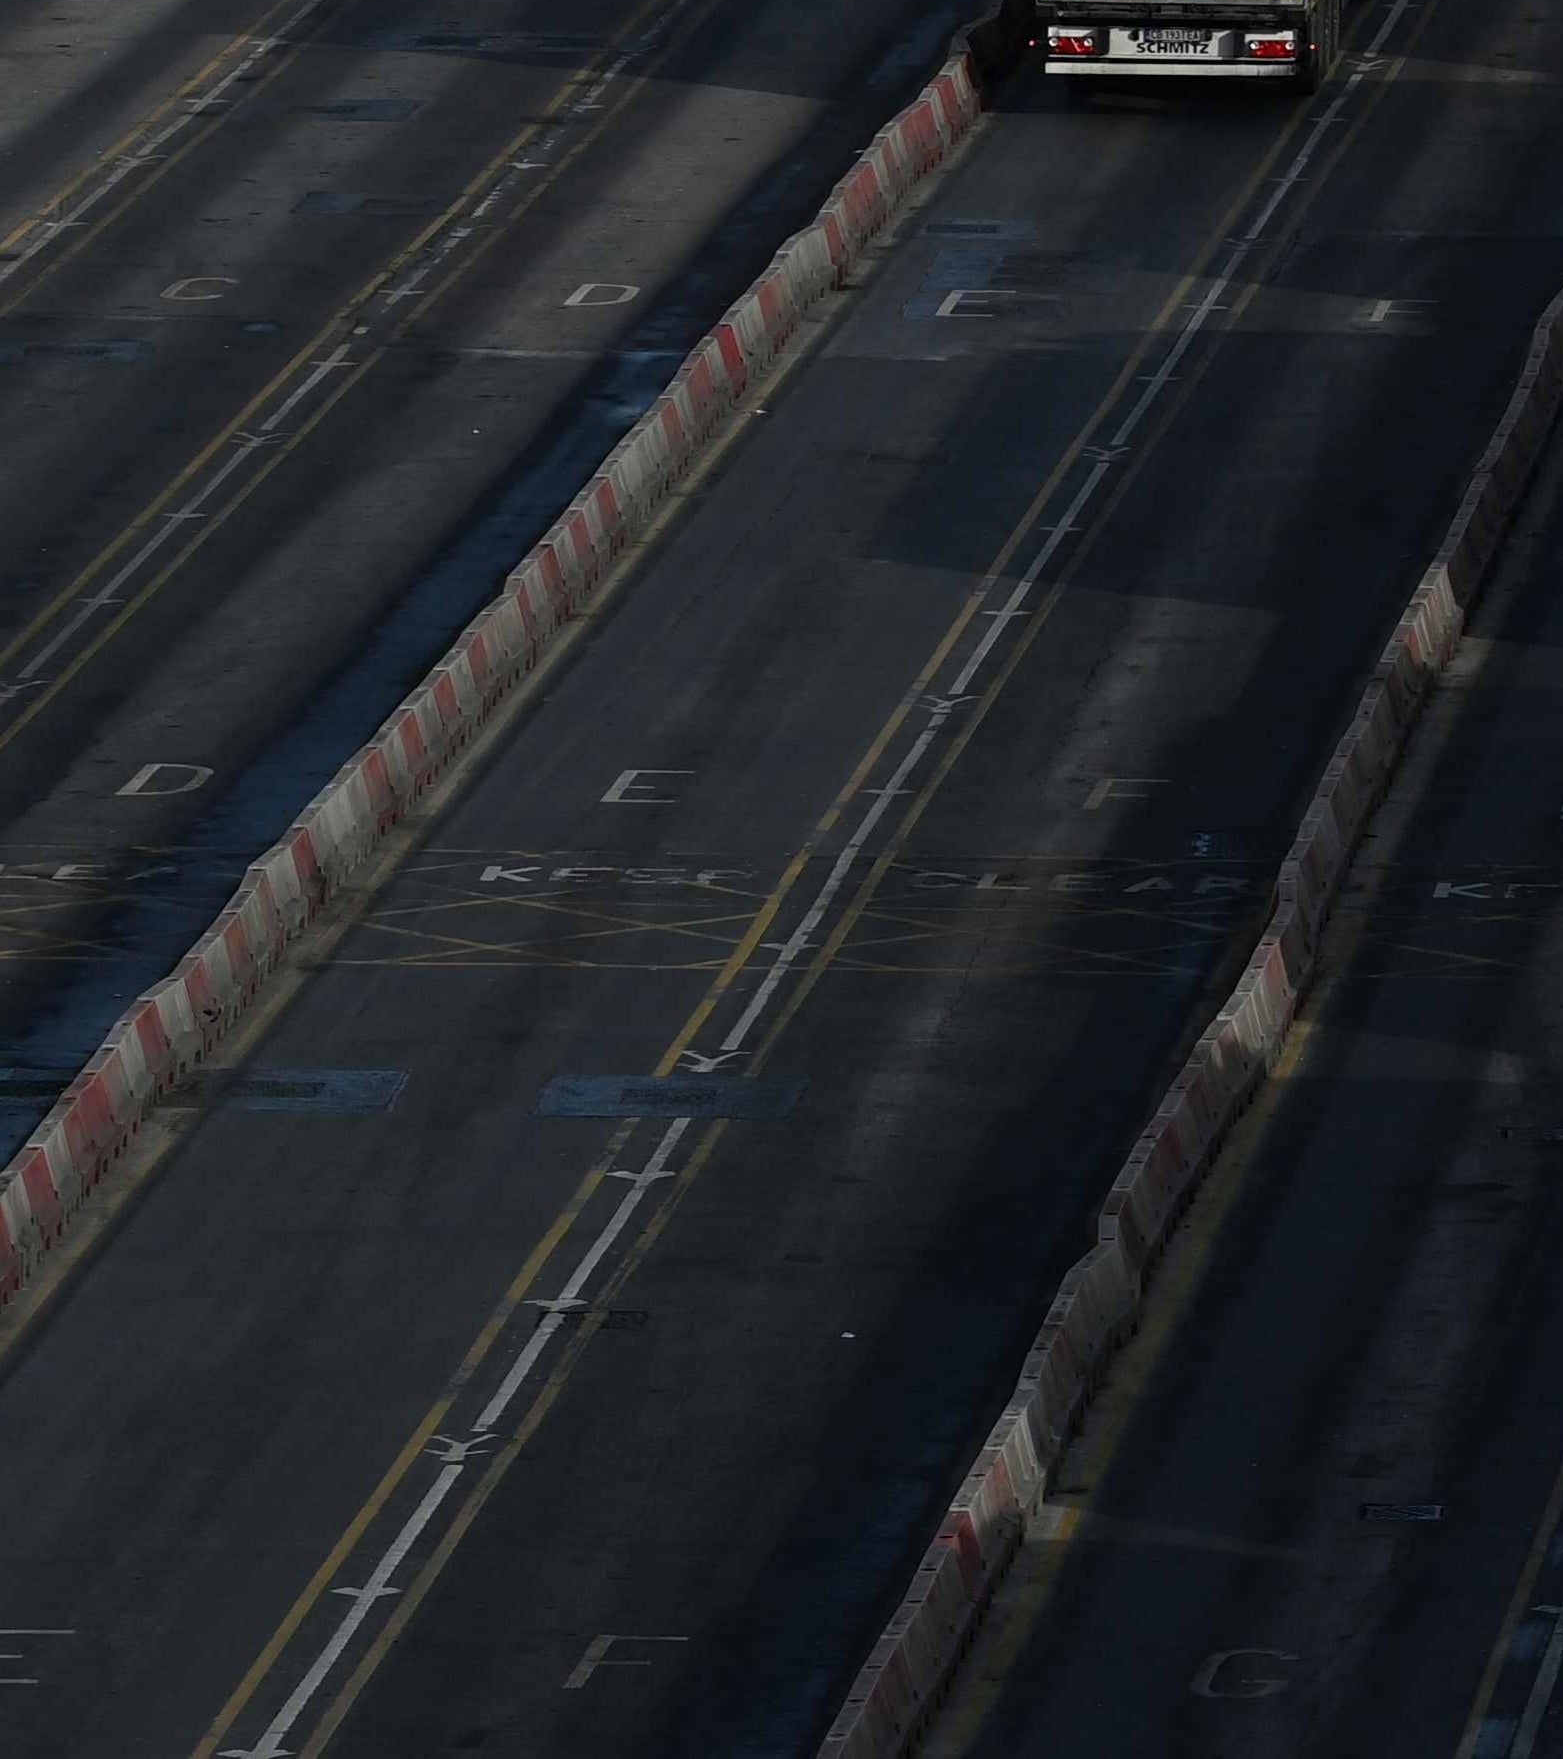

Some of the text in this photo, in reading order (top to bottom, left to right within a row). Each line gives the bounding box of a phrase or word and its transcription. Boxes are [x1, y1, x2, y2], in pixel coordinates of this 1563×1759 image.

[1137, 42, 1210, 53] SCHMITZ
[159, 277, 239, 300] C
[564, 283, 639, 305] D
[934, 290, 1016, 316] E
[1368, 299, 1439, 324] F
[114, 763, 215, 797] D
[600, 769, 696, 804] E
[564, 1634, 691, 1688] F
[1192, 1647, 1301, 1700] G
